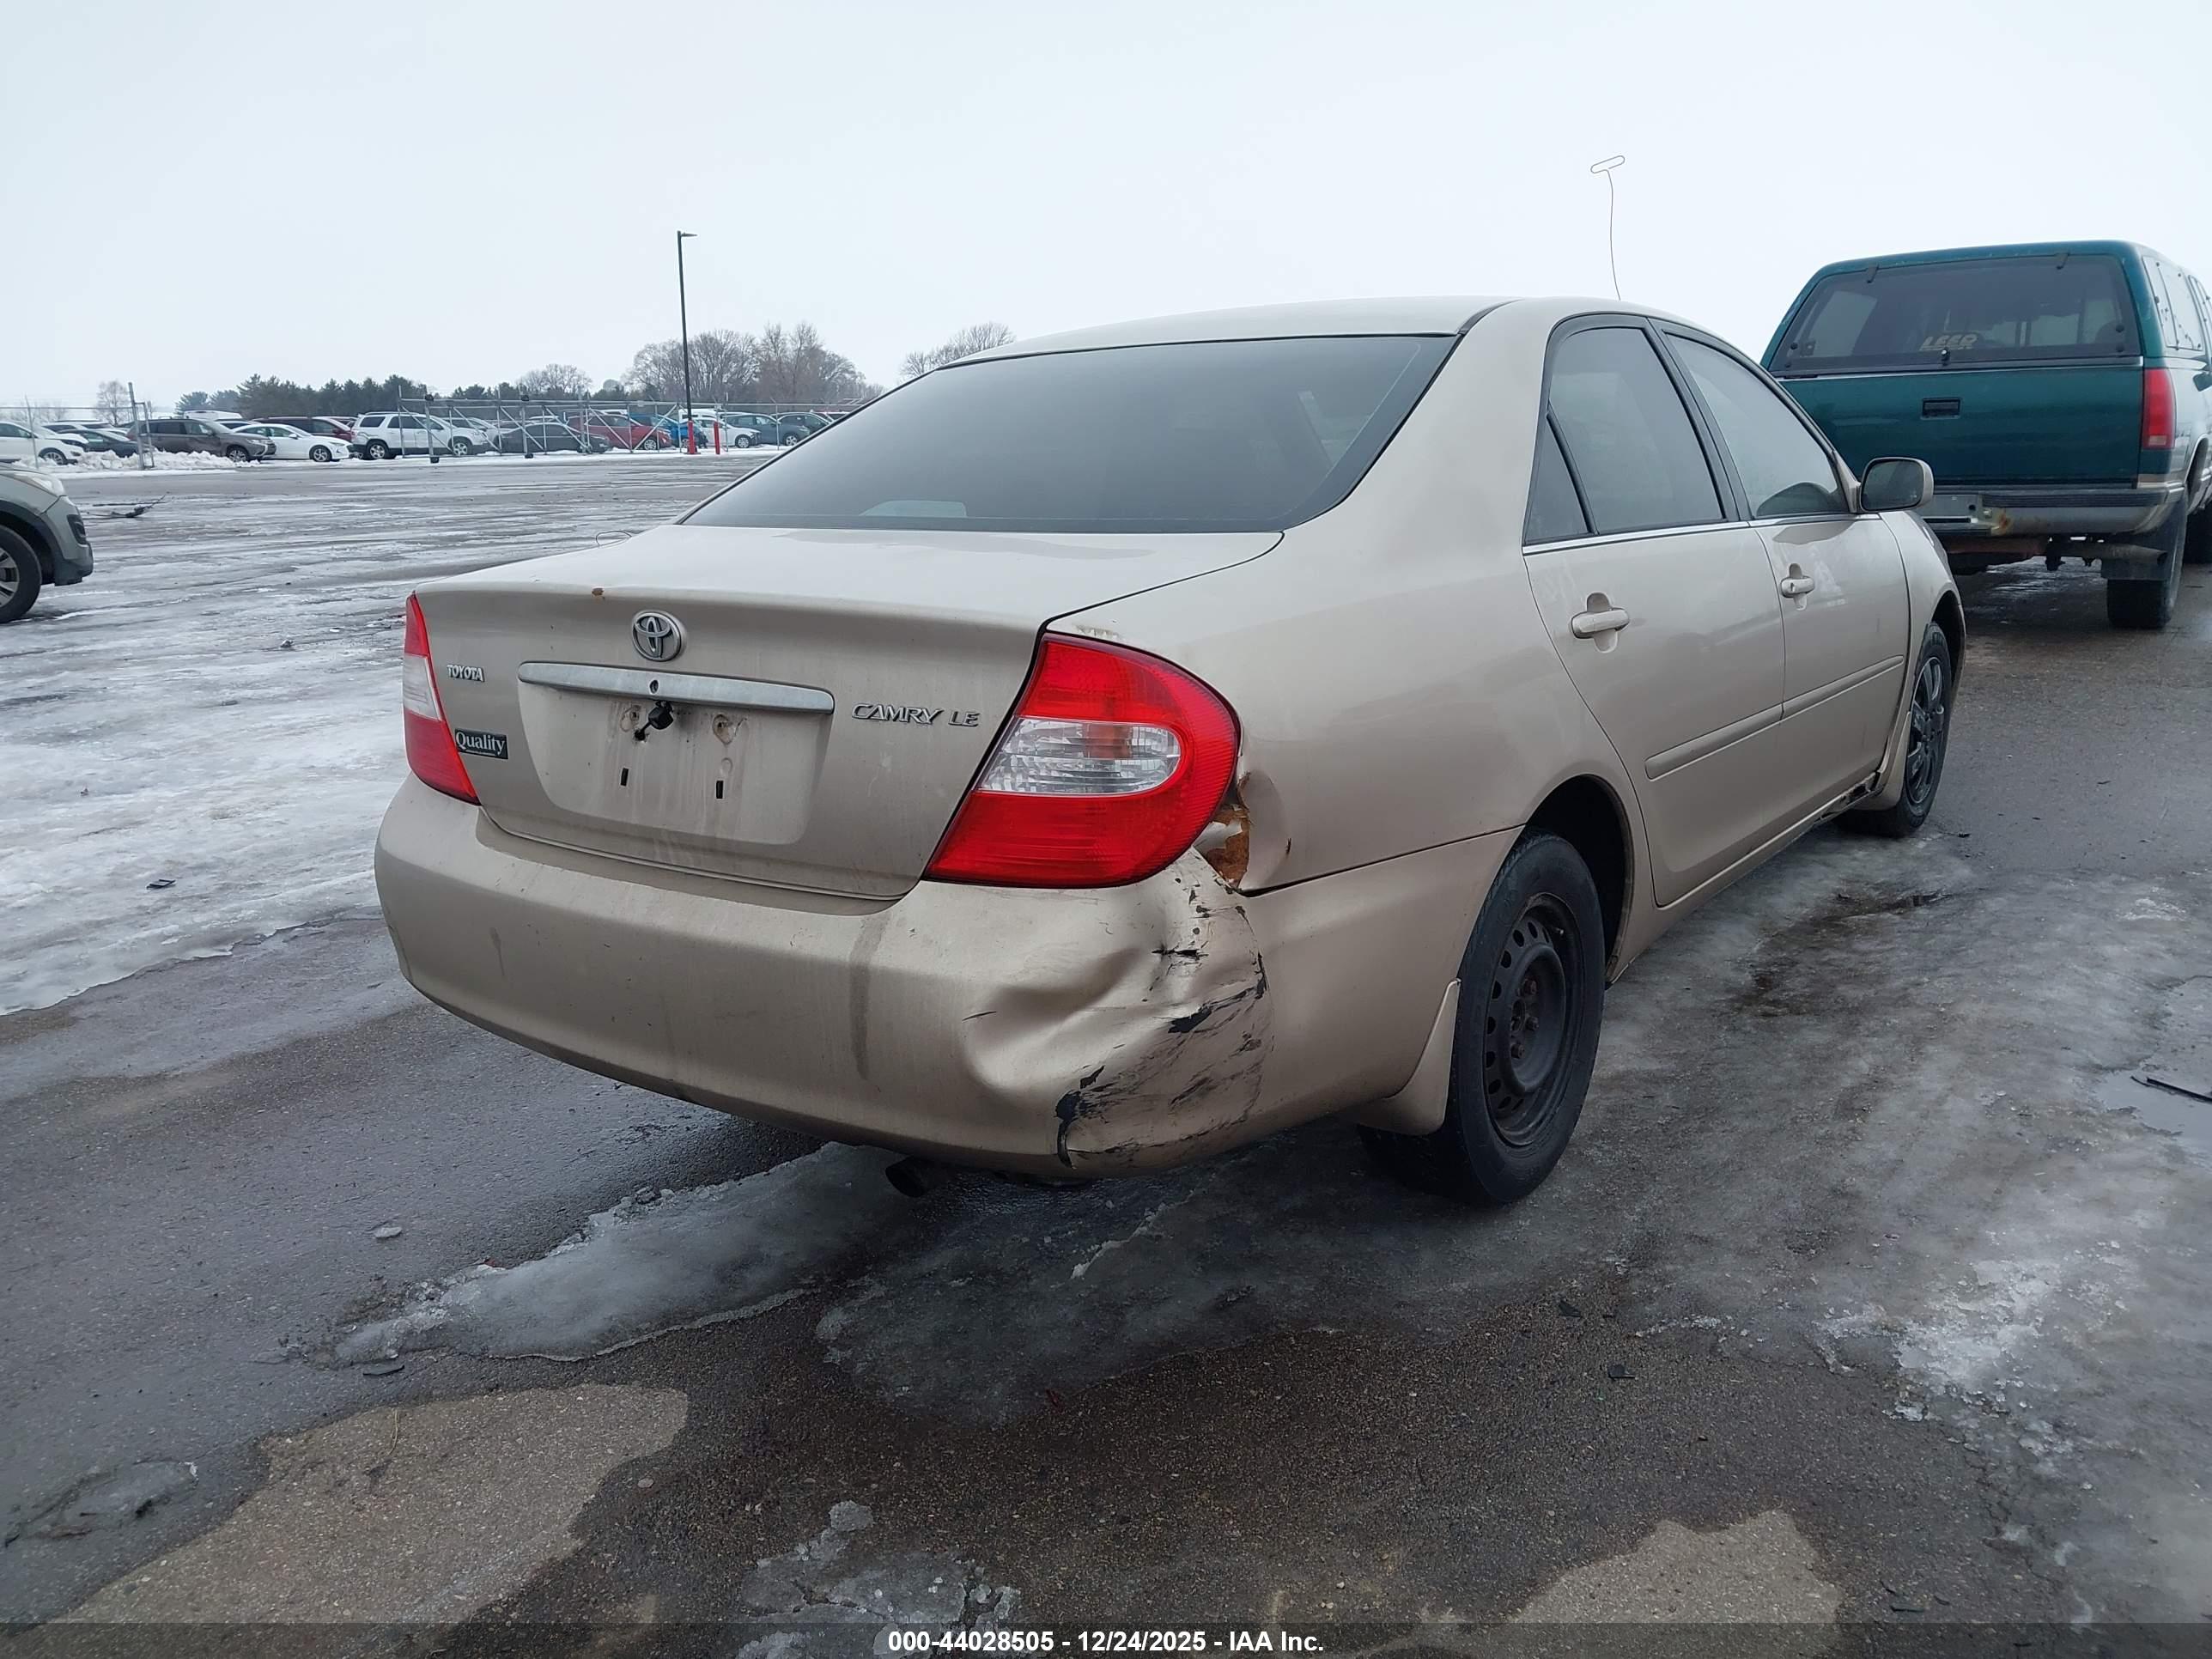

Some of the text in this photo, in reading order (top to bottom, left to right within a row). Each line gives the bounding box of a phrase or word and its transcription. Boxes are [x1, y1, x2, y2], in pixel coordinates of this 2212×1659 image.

[447, 665, 484, 682] TOYOTA
[852, 703, 980, 726] CAMRY LE
[455, 731, 505, 755] Quality
